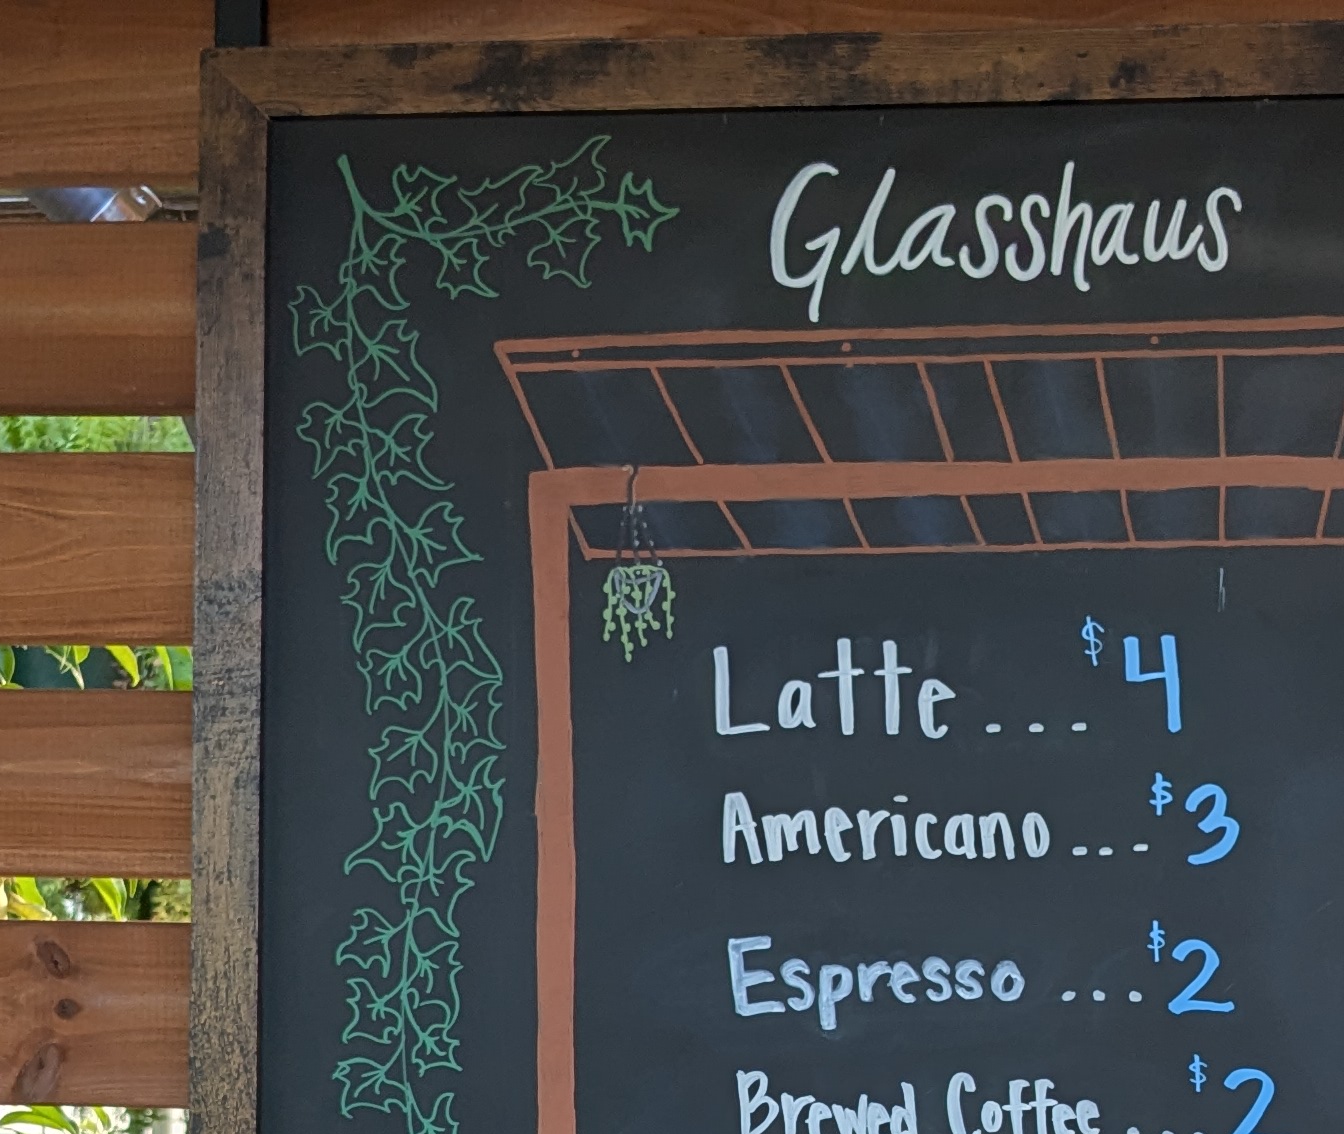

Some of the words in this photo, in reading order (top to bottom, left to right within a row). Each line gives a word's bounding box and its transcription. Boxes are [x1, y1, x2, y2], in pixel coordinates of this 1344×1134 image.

[768, 162, 1244, 322] Glasshaus
[713, 637, 956, 739] Latte
[1081, 615, 1183, 733] $4
[723, 791, 1051, 865] Americano
[1148, 771, 1240, 865] $3
[727, 935, 1026, 1032] Espresso
[1146, 919, 1235, 1014] $2
